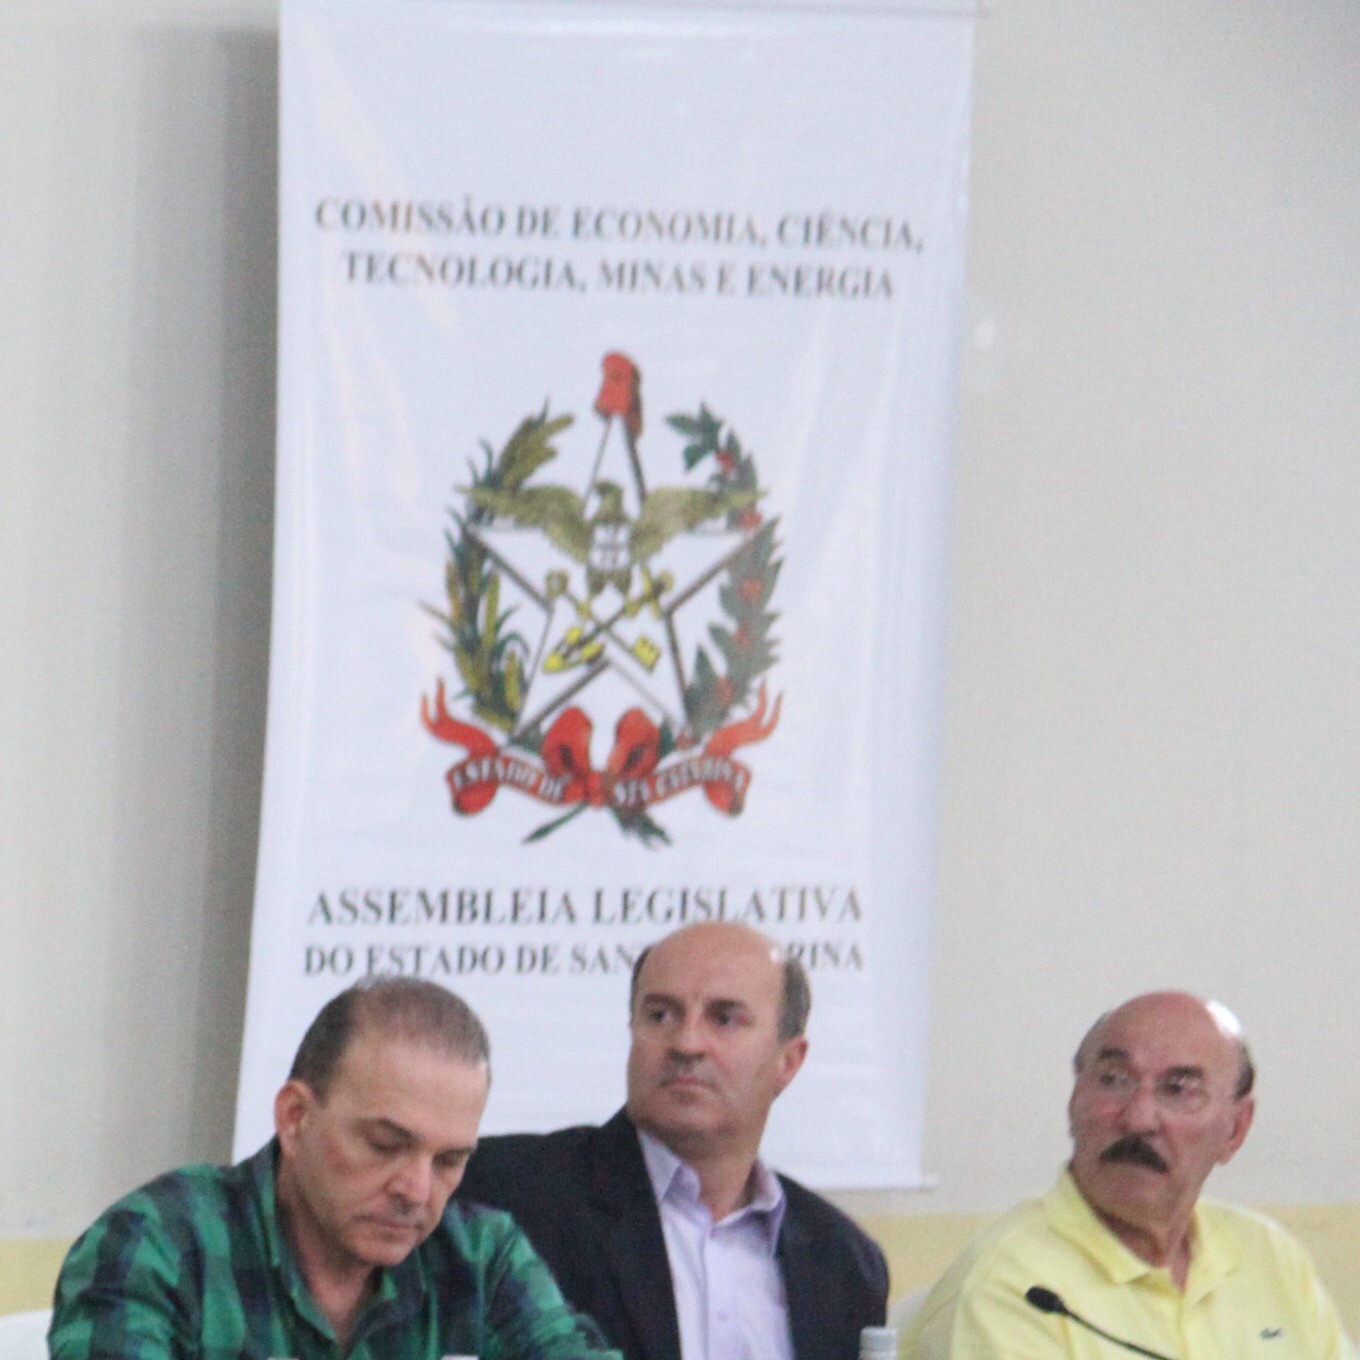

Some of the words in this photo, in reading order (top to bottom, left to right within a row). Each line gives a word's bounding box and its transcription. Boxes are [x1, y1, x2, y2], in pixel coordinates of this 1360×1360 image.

[315, 194, 507, 236] COMISSÃO
[516, 204, 560, 238] DE
[571, 204, 768, 248] ECONOMIA,
[777, 206, 923, 254] CIÊNCIA,
[344, 251, 587, 294] TECNOLOGIA,
[599, 258, 707, 294] MINAS
[716, 262, 734, 295] E
[746, 263, 895, 299] ENERGIA
[306, 886, 578, 926] ASSEMBLEIA
[591, 885, 864, 924] LEGISLATIVA
[302, 943, 355, 976] DO
[365, 943, 506, 976] ESTADO
[514, 943, 559, 975] DE
